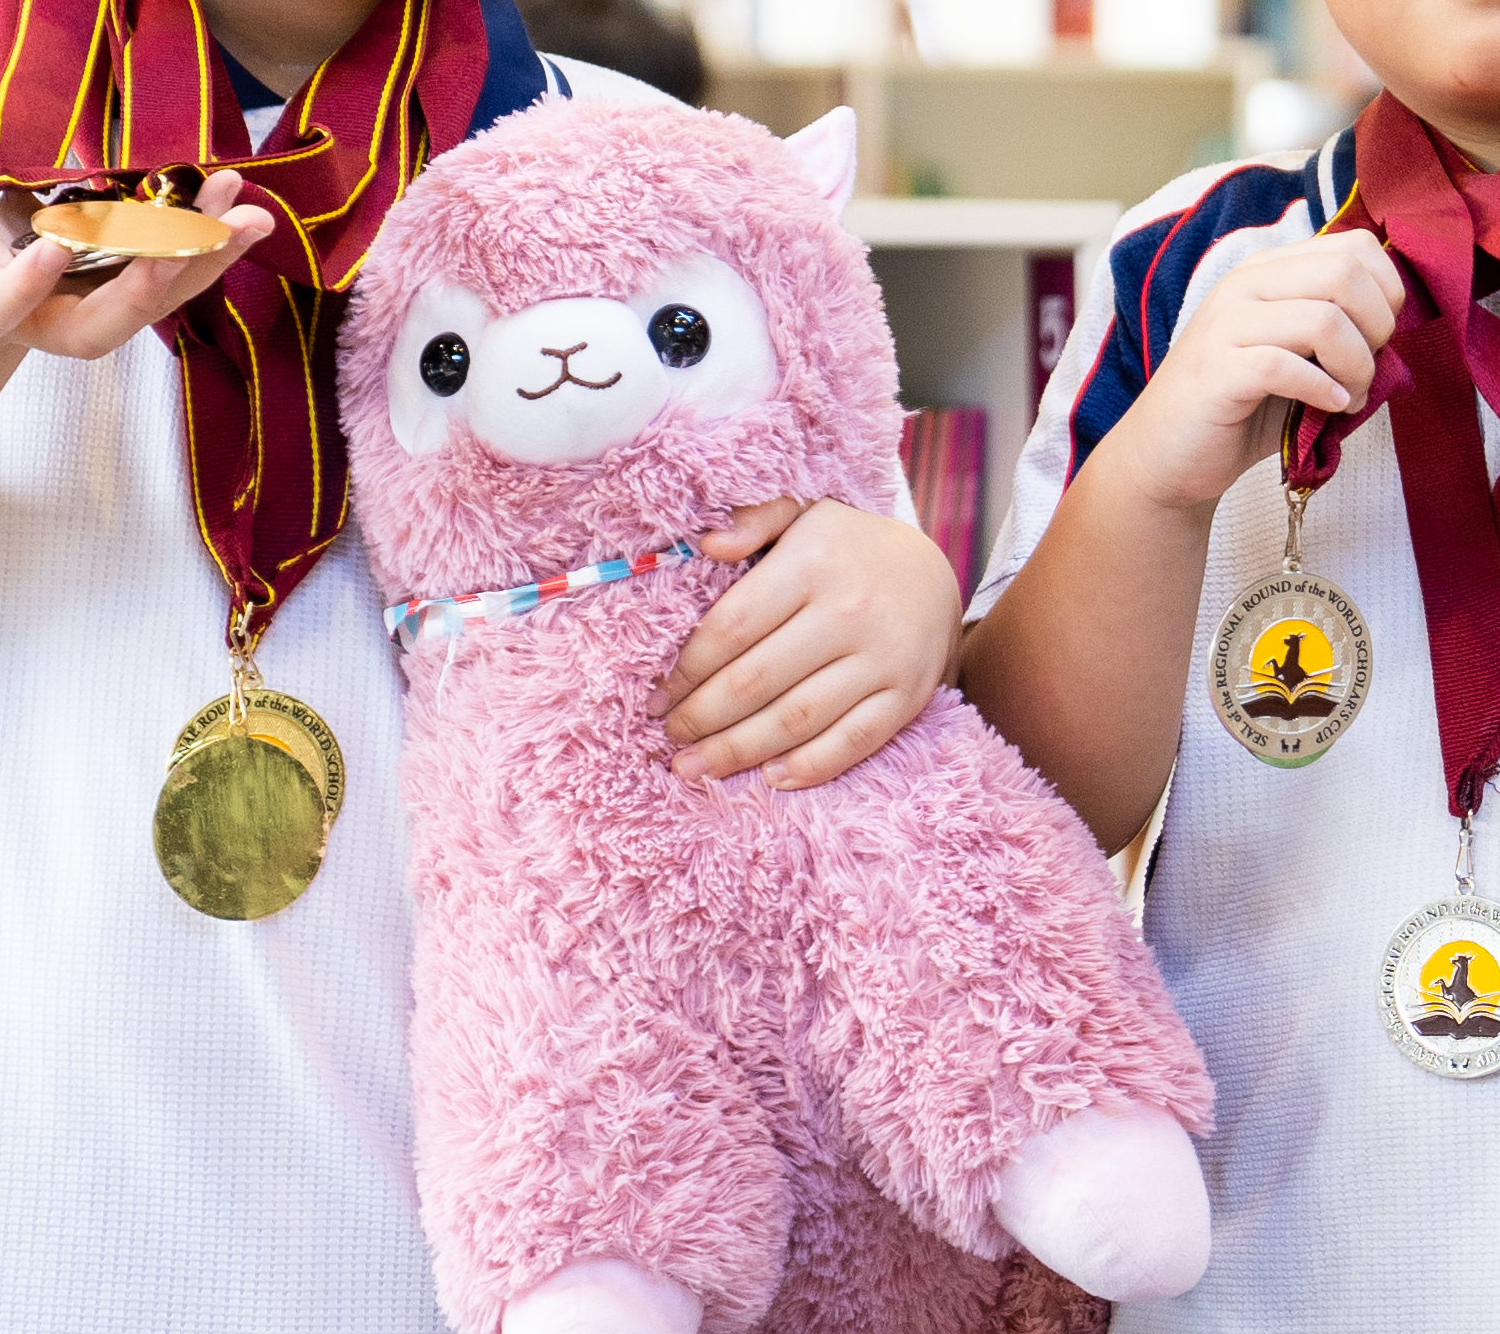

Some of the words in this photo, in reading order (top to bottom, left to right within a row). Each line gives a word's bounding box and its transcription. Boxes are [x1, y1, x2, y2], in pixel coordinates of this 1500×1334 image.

[1242, 580, 1291, 612] ROUND
[1295, 581, 1308, 594] of
[1308, 583, 1326, 598] the
[1328, 589, 1363, 639] WORLD
[1215, 612, 1244, 688] REGIONAL
[1339, 640, 1368, 721] SCHOLAR'S
[1220, 691, 1235, 709] the
[254, 696, 269, 709] of
[269, 698, 289, 713] the
[291, 703, 333, 752] WORLD
[1227, 709, 1243, 723] of
[1240, 723, 1269, 748] SEAL
[1315, 719, 1341, 744] CUP
[1381, 944, 1403, 1009] GLOBAL
[1400, 903, 1449, 945] ROUND
[1453, 901, 1467, 914] of
[1469, 902, 1488, 917] the
